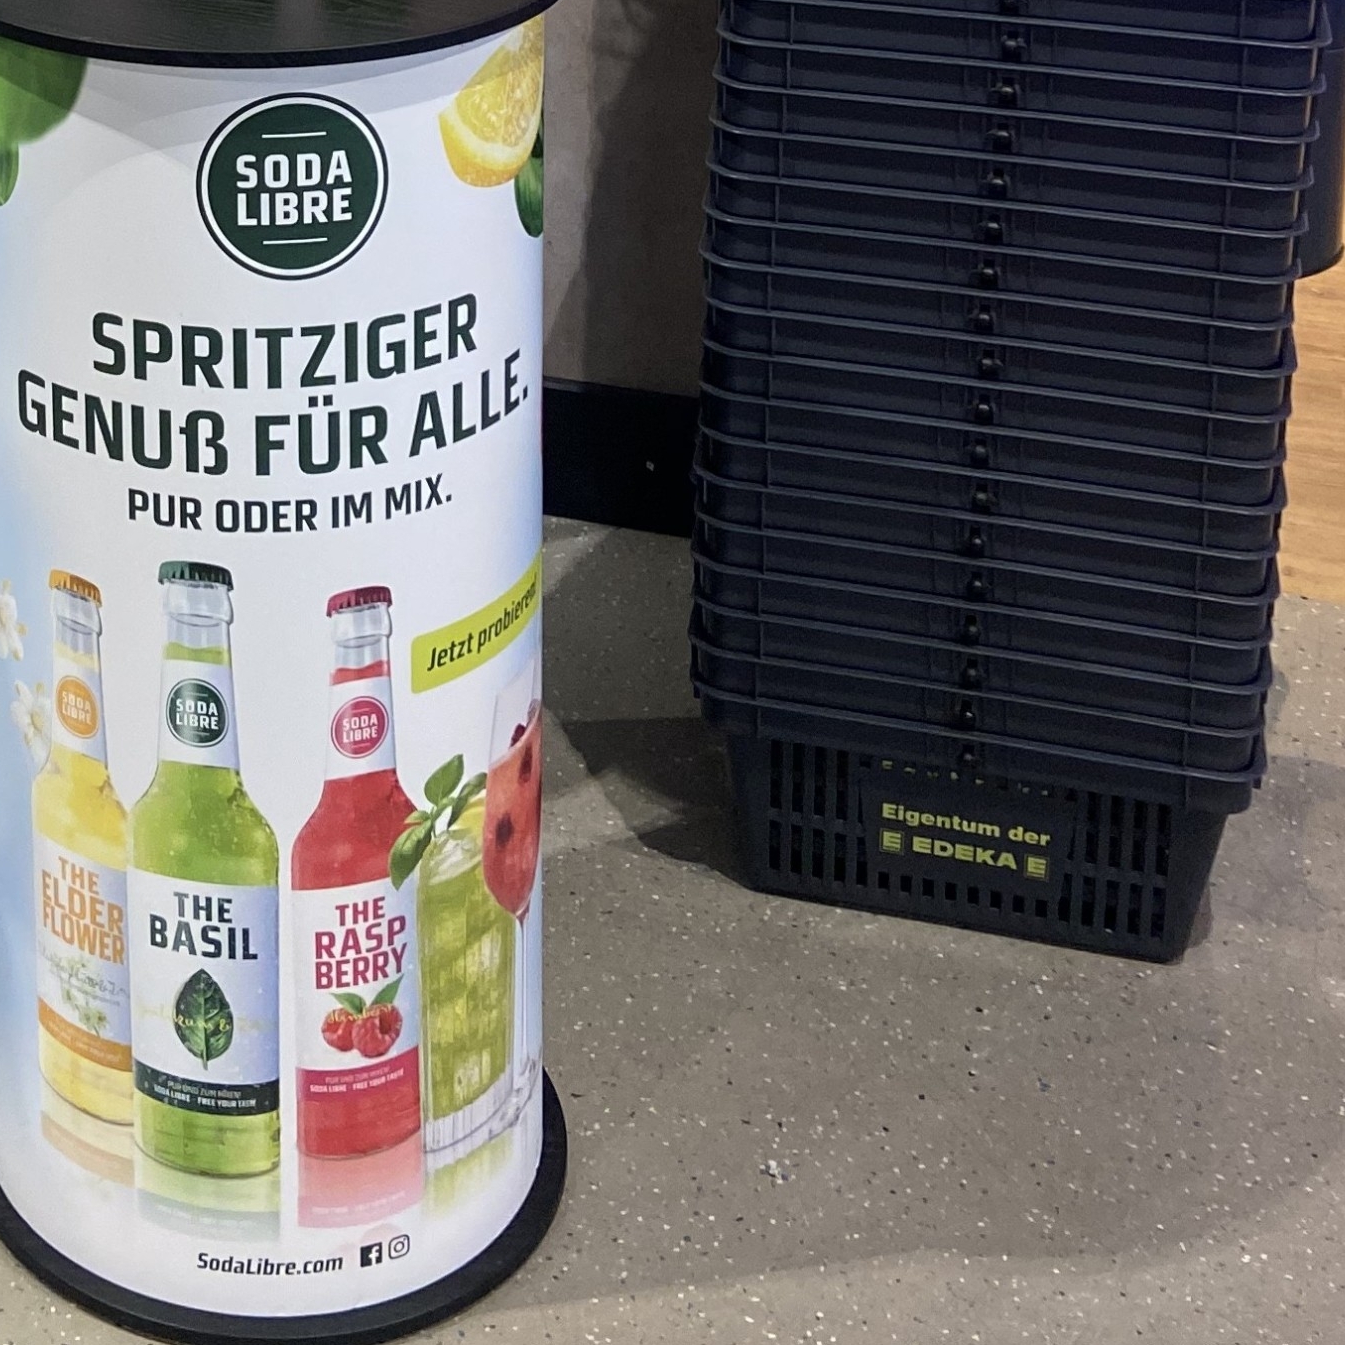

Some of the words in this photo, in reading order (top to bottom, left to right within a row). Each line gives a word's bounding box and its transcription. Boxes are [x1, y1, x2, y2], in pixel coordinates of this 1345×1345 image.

[235, 150, 352, 190] SODA
[236, 188, 353, 227] LIBRE
[91, 291, 478, 390] SPRITZIGER
[255, 394, 388, 476] FÜR
[408, 347, 529, 459] ALLE.
[127, 487, 202, 531] PUR
[215, 498, 318, 533] ODER
[331, 491, 372, 529] IM
[384, 473, 453, 516] MIX.
[426, 632, 475, 672] Jetzt
[476, 571, 538, 654] probieren!
[61, 689, 91, 711] SODA
[61, 702, 93, 725] LIBRE
[173, 696, 219, 716] SODA
[174, 710, 220, 731] LIBRE
[341, 713, 378, 732] SODA
[341, 725, 379, 744] LIBRE
[881, 802, 1001, 839] Eigentum
[1008, 826, 1051, 847] der
[912, 835, 1018, 871] EDEKA
[57, 855, 101, 894] THE
[41, 871, 124, 934] ELDER
[172, 890, 233, 924] THE
[334, 895, 387, 928] THE
[41, 898, 126, 967] FLOWER
[148, 914, 259, 962] BASIL
[313, 914, 407, 961] RASP
[313, 942, 407, 991] BERRY
[195, 1251, 344, 1277] SodaLibre.com
